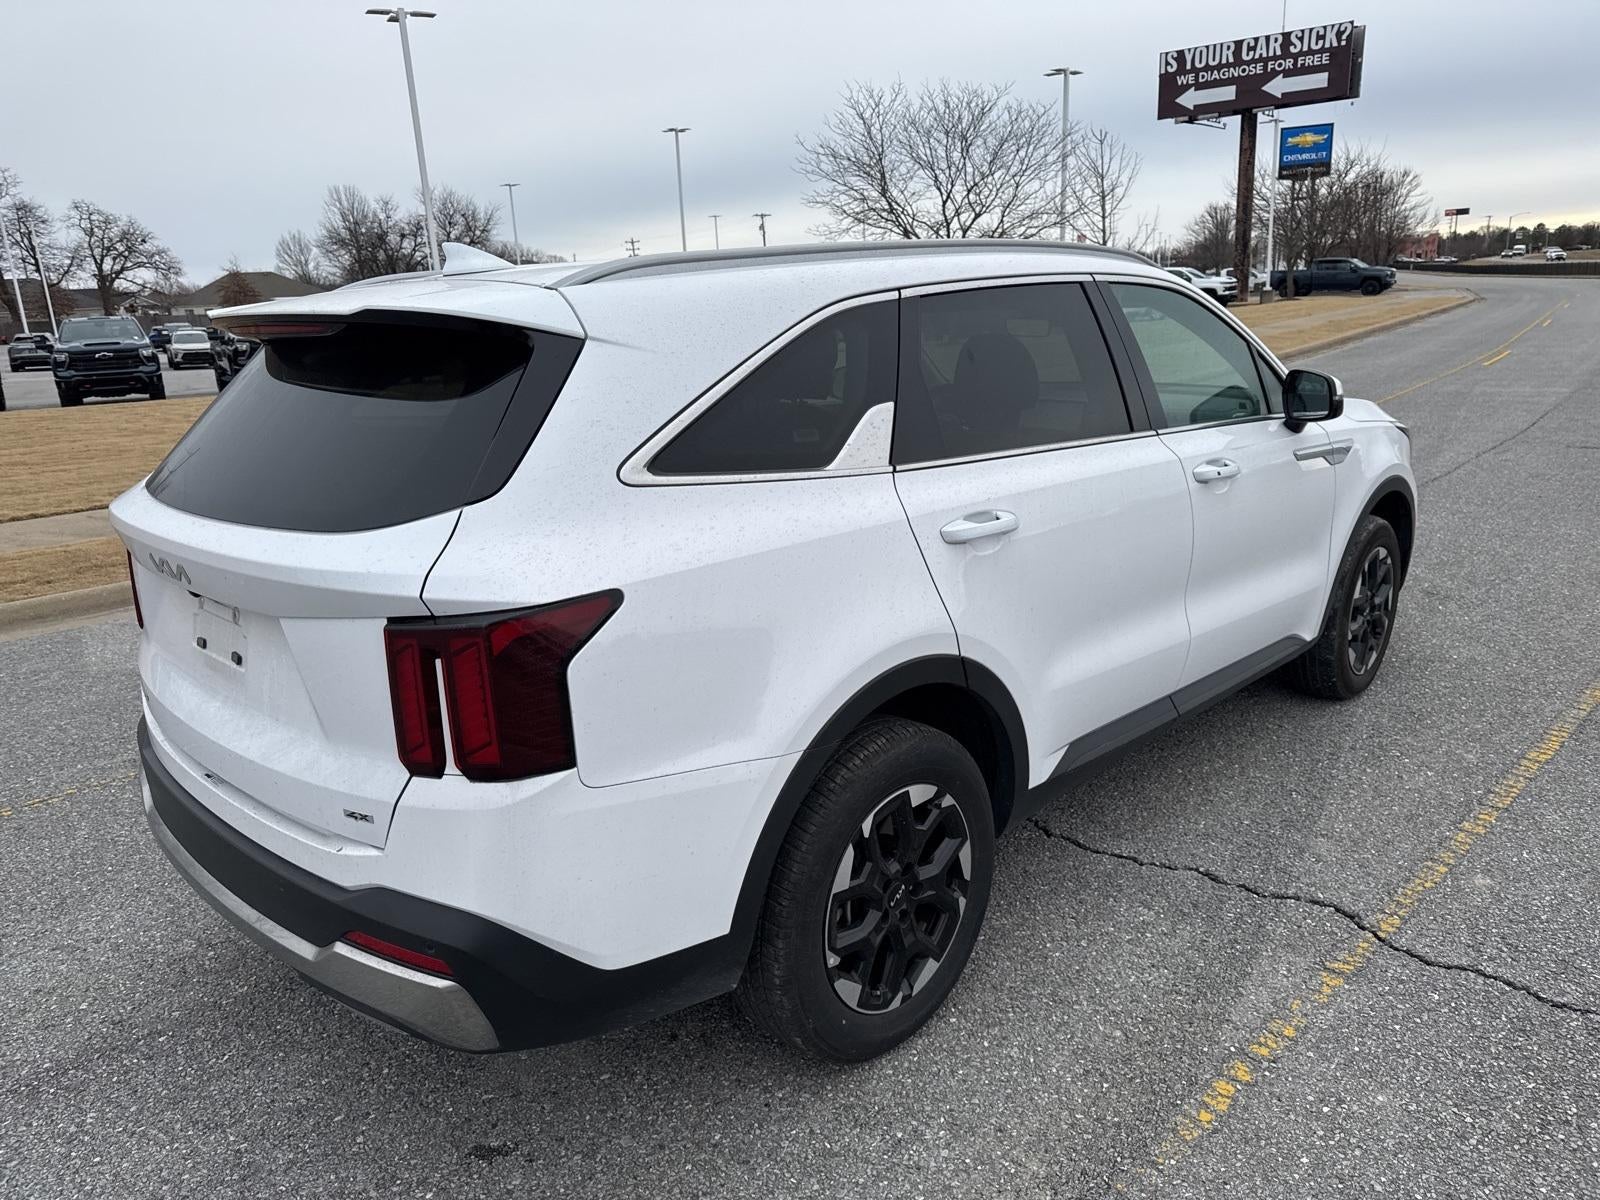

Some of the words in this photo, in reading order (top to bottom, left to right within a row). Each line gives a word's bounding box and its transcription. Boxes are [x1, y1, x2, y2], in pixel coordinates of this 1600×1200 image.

[1160, 51, 1178, 74] IS
[1184, 41, 1235, 70] YOUR
[1241, 33, 1284, 61] CAR
[1290, 22, 1353, 53] SICK?
[1176, 74, 1196, 86] WE
[1199, 65, 1264, 82] DIAGNOSE
[1268, 59, 1294, 72] FOR
[1297, 53, 1330, 68] FREE
